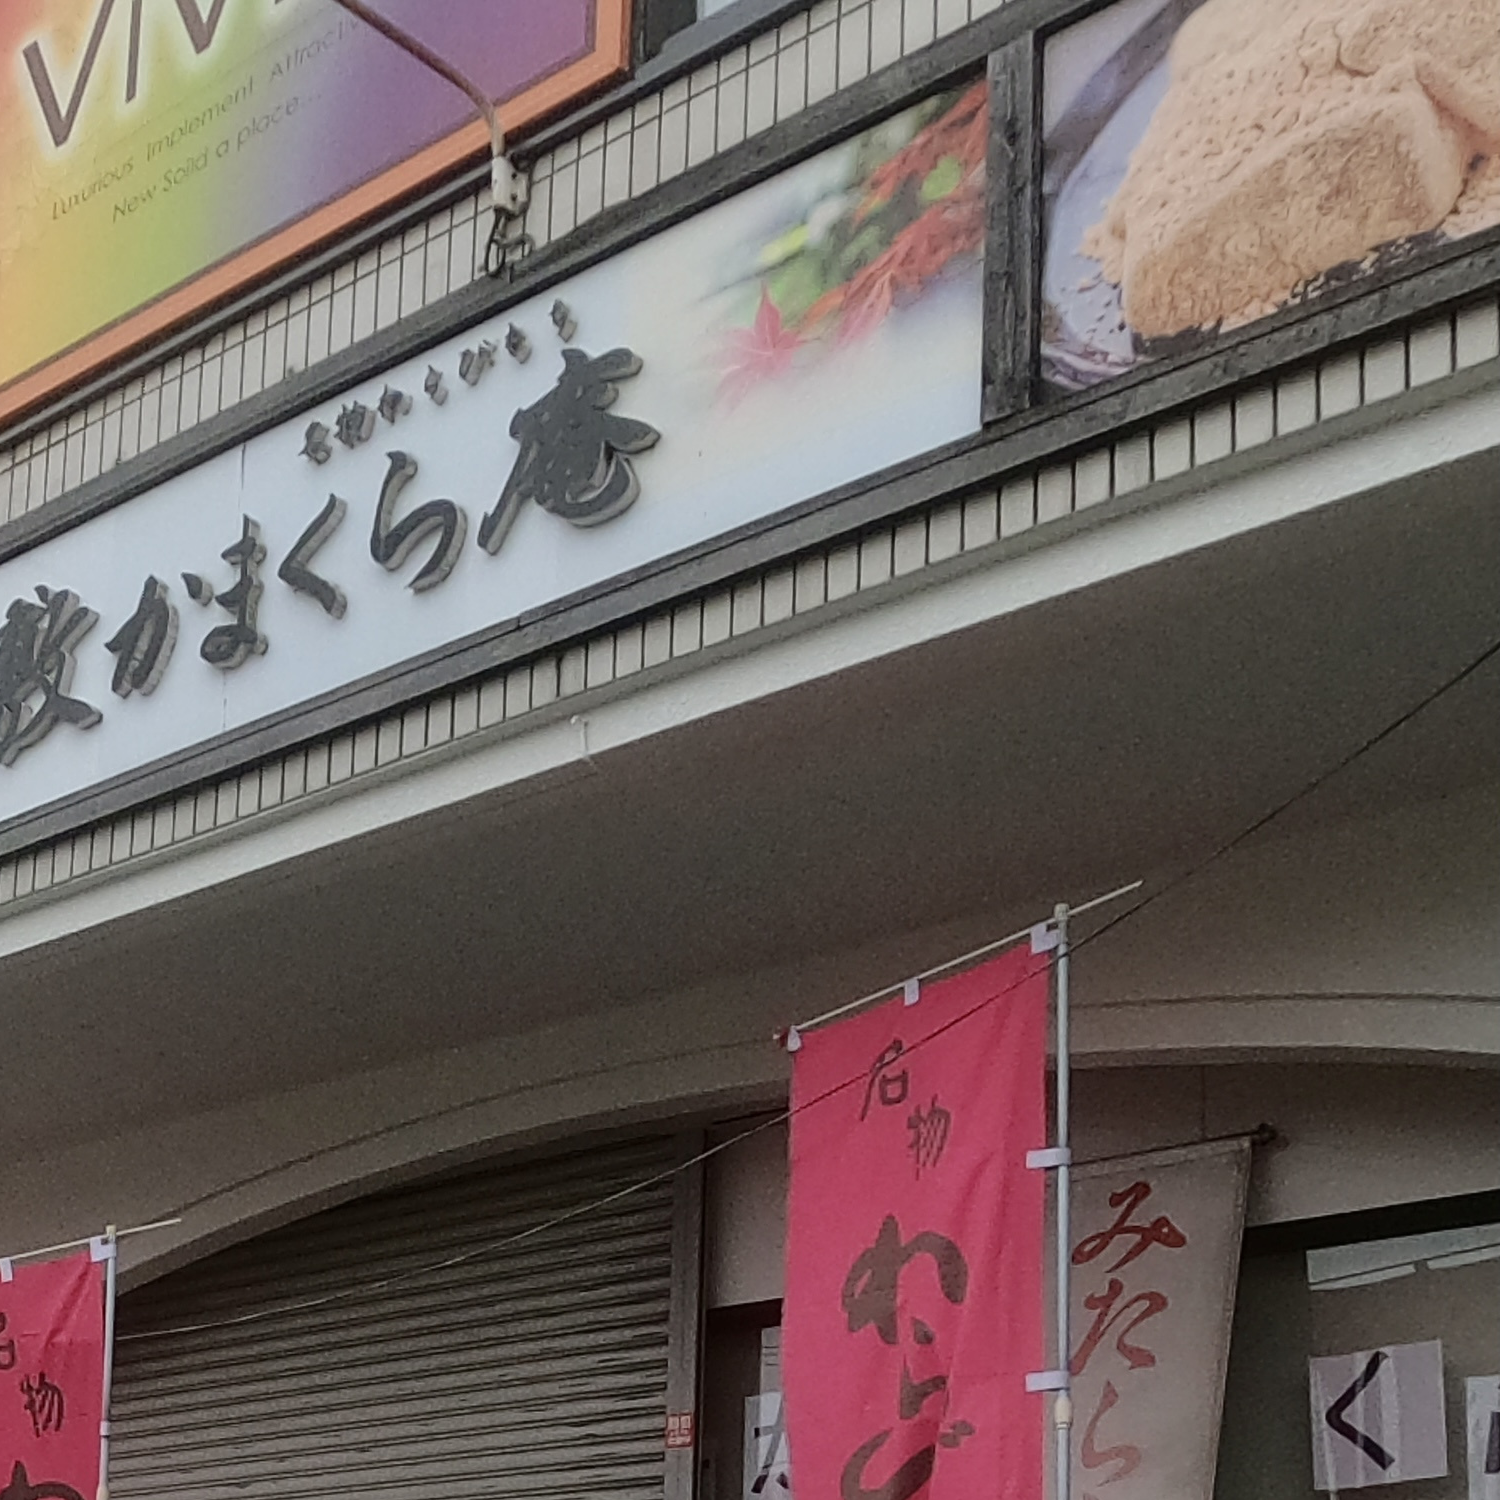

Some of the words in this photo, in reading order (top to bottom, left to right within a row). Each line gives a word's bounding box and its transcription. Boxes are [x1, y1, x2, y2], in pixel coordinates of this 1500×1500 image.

[146, 76, 254, 162] Implement
[112, 186, 157, 223] New
[163, 147, 208, 192] Solid
[216, 139, 229, 159] a
[860, 1038, 951, 1181] 名物
